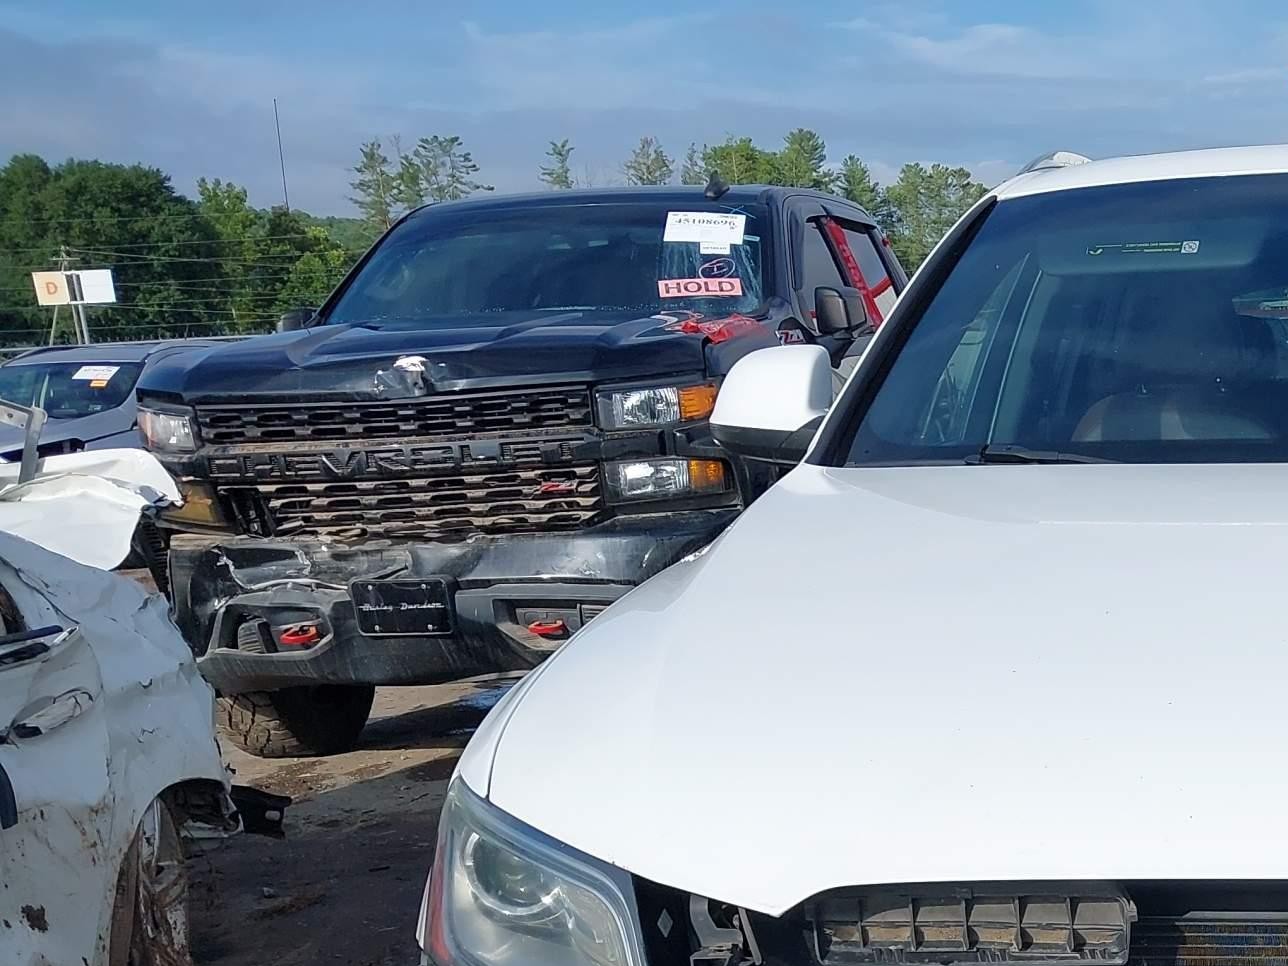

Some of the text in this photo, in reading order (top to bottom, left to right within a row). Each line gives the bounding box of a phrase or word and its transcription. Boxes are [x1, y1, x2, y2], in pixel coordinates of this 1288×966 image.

[46, 282, 58, 295] D
[663, 280, 736, 294] HOLD
[206, 437, 587, 479] CHEVROLET
